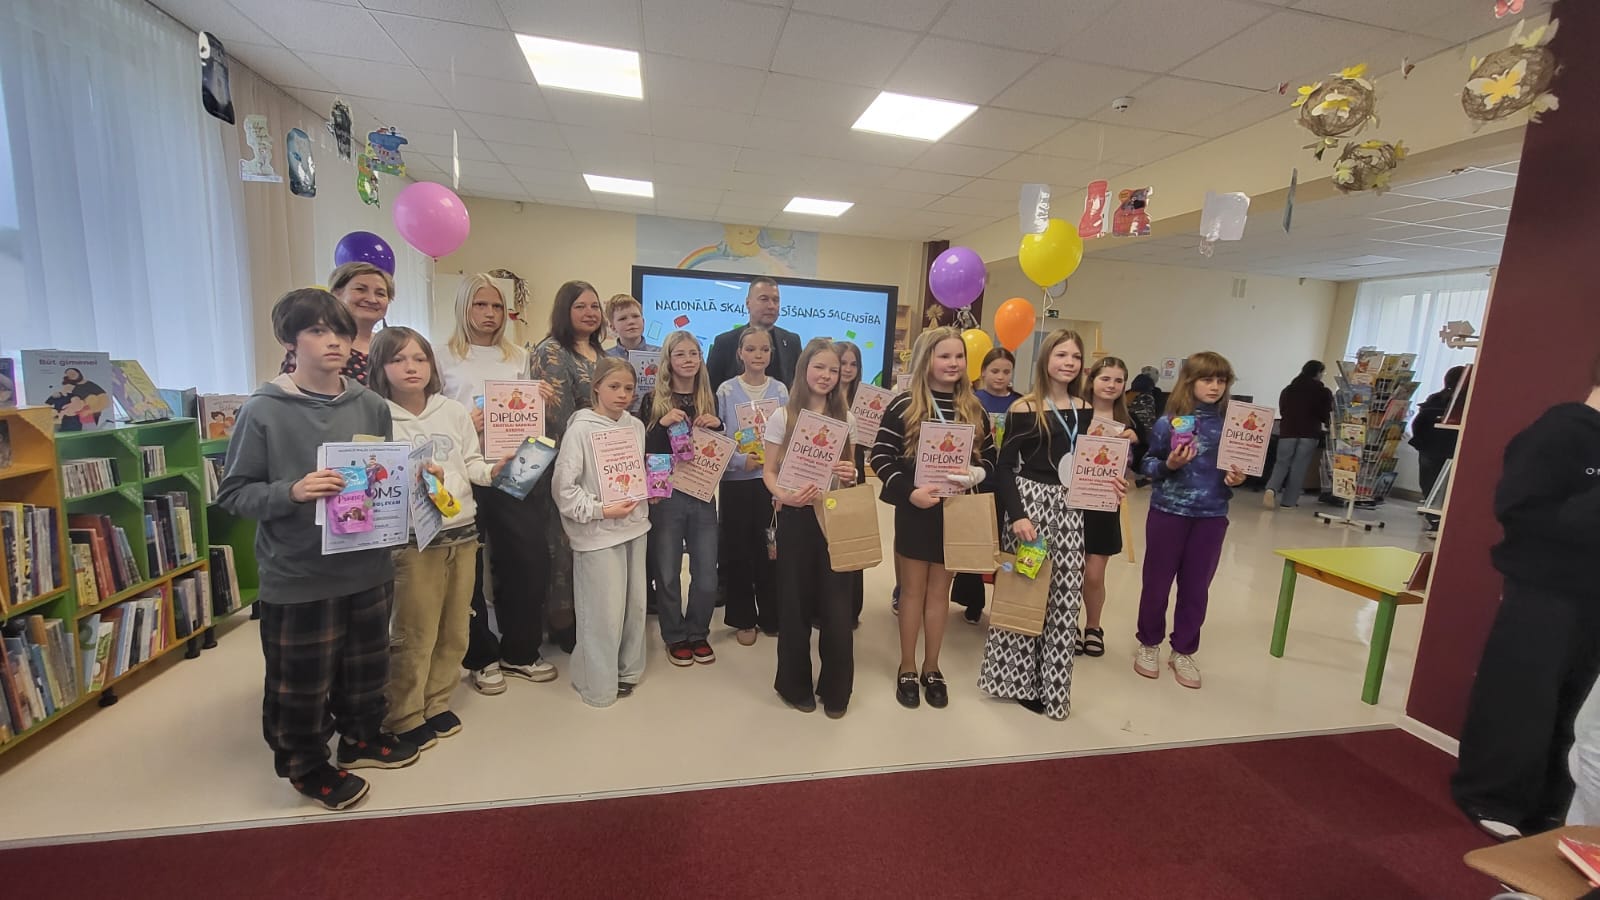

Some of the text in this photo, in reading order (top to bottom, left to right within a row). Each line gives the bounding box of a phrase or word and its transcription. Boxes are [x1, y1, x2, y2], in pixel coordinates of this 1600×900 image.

[655, 299, 717, 312] NACIONĀLĀ
[720, 302, 748, 316] SKAĻ
[781, 305, 826, 319] SĪŠANAS
[490, 412, 539, 423] DIPLOMS
[853, 406, 882, 420] DIPLOM
[1225, 428, 1265, 444] DIPLOMS
[792, 442, 835, 462] DIPLOMS
[921, 452, 965, 464] DIPLOMS
[603, 459, 641, 475] DIPLOMS
[693, 454, 721, 472] PLOMS
[1075, 464, 1119, 478] DIPLOMS
